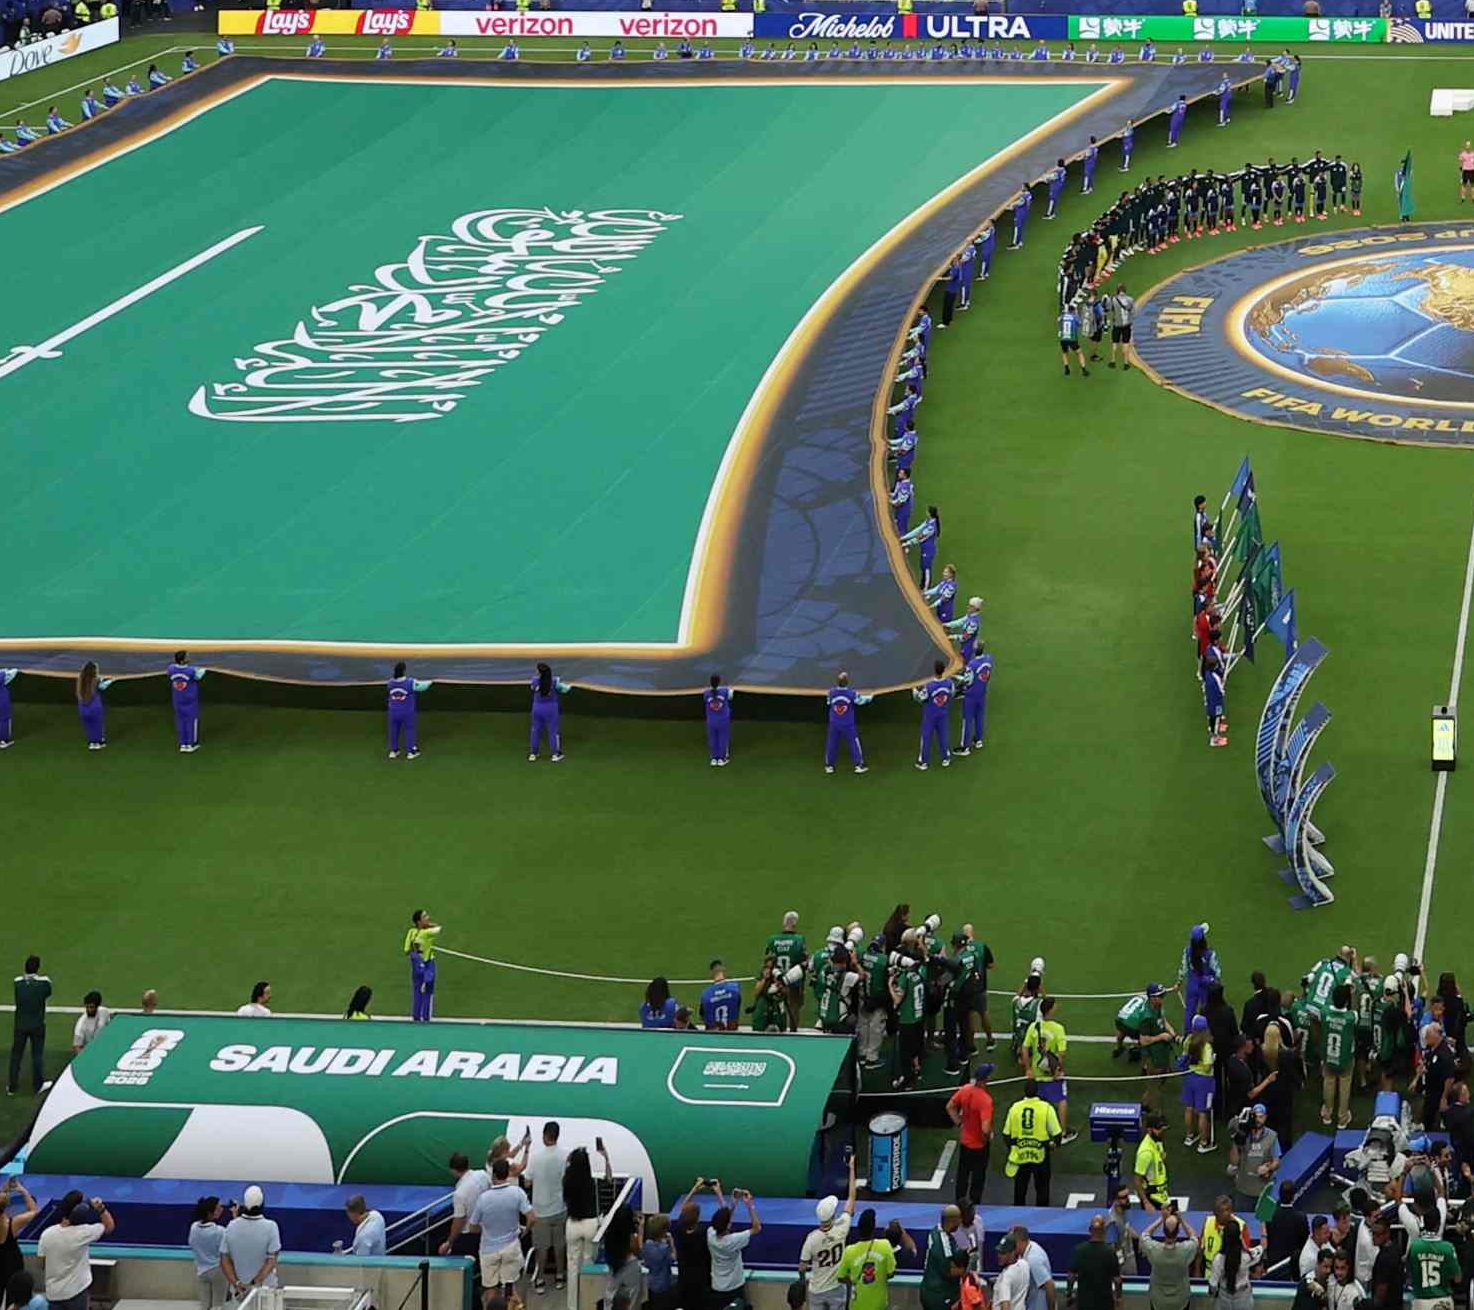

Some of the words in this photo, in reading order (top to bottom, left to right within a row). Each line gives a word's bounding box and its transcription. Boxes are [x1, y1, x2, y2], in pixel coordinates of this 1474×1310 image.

[264, 9, 311, 33] Lay's
[362, 9, 410, 33] Lay's
[476, 15, 573, 35] verizon
[619, 13, 717, 36] verizon
[789, 12, 894, 38] Michelob
[928, 17, 1030, 38] ULTRA
[8, 44, 53, 78] Dove
[1298, 231, 1421, 257] 2026
[1155, 294, 1214, 339] FIFA
[1241, 387, 1322, 416] FIFA
[209, 1043, 390, 1079] SAUDI
[404, 1049, 618, 1085] ARABIA
[1094, 1106, 1136, 1116] Hisense
[817, 1243, 843, 1268] 20
[1421, 1260, 1441, 1289] 15
